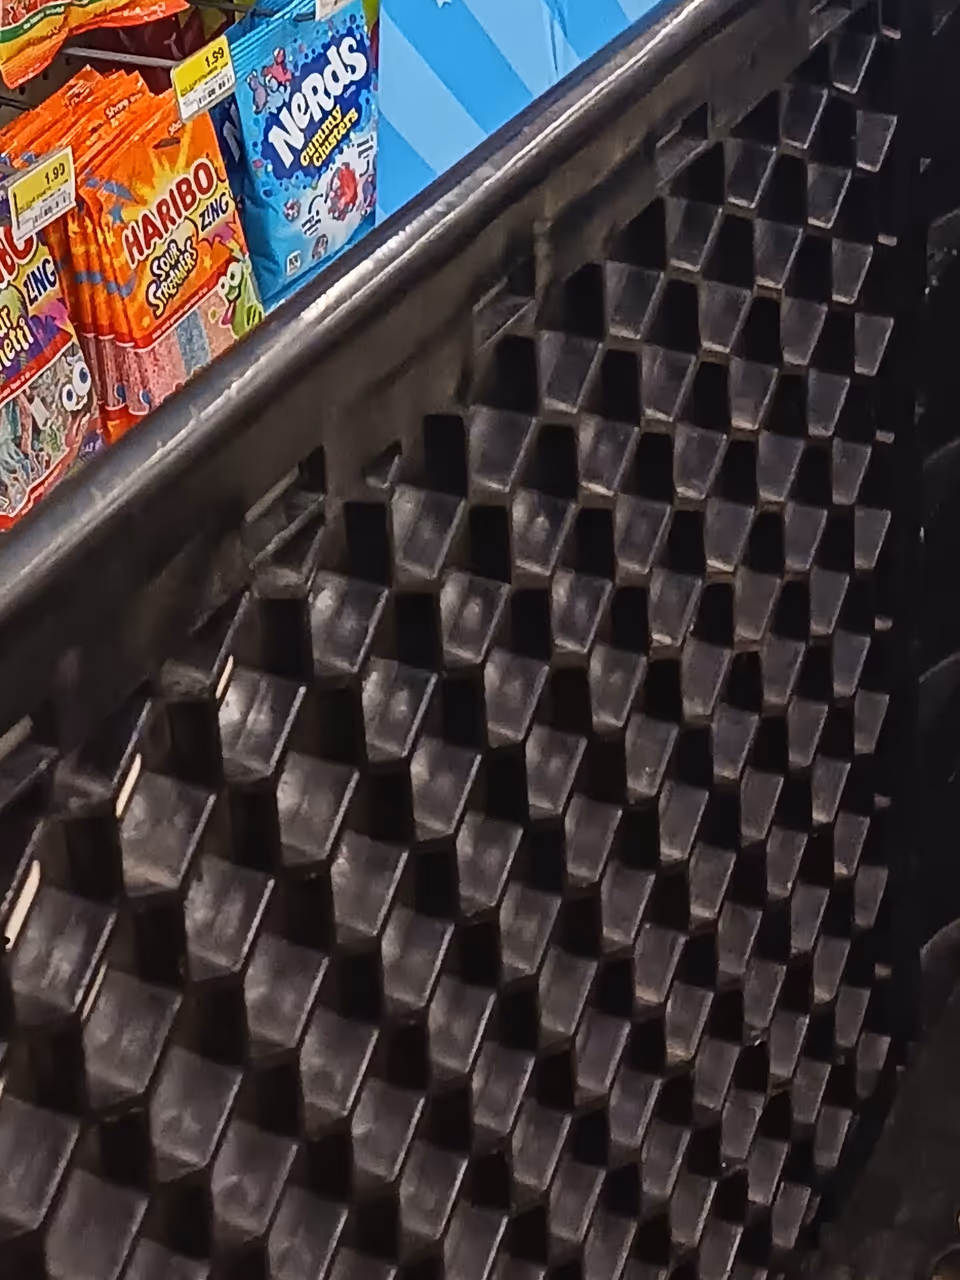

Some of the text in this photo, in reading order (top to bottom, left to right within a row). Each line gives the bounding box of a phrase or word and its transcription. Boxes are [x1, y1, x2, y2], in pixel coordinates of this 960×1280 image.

[204, 46, 226, 68] 1.99
[122, 160, 214, 269] HARIBO
[199, 198, 230, 233] ZING
[22, 257, 58, 310] ZING
[147, 236, 198, 317] STREAMERS
[153, 239, 180, 283] SOUR
